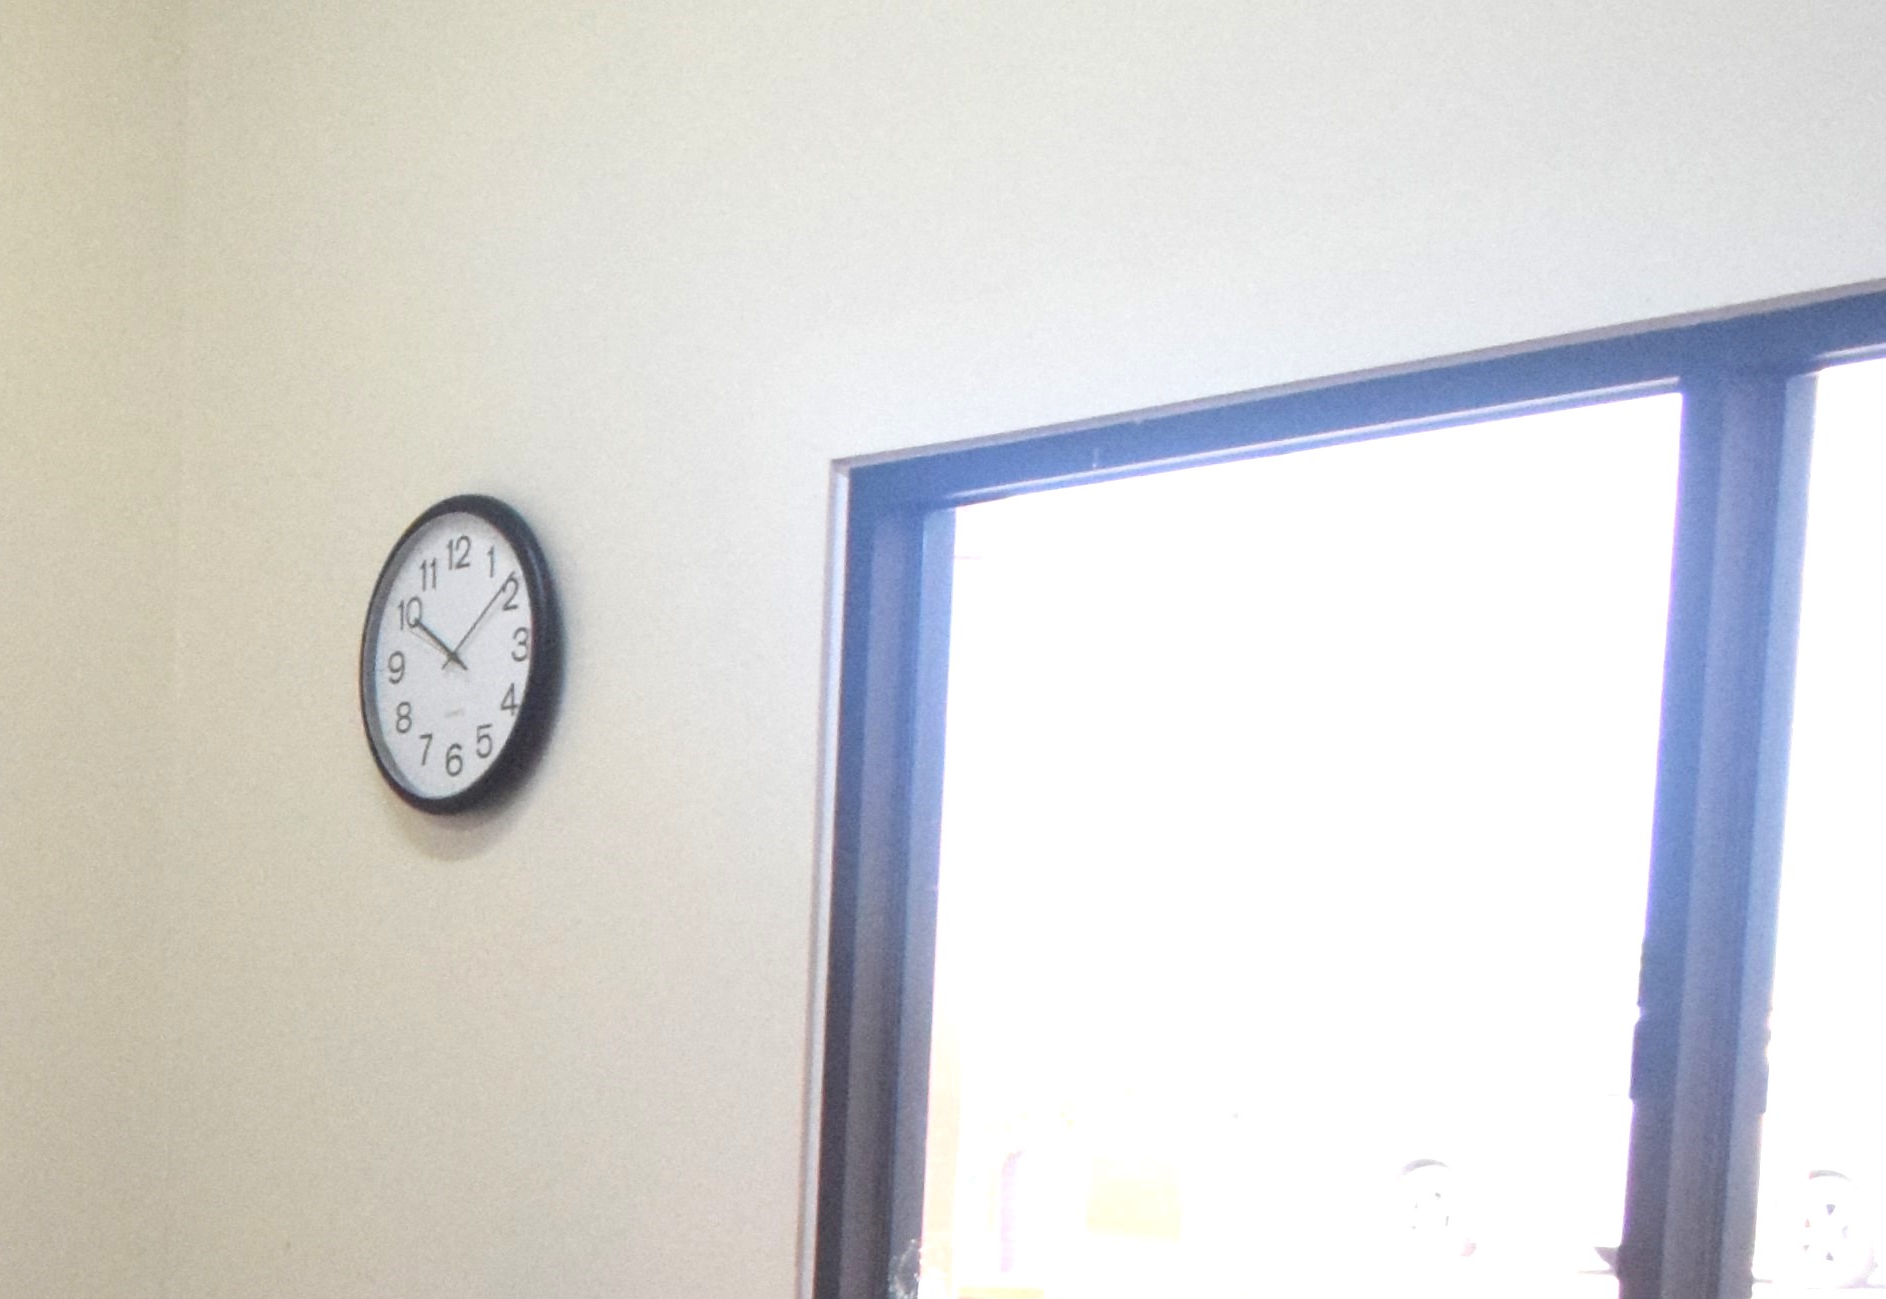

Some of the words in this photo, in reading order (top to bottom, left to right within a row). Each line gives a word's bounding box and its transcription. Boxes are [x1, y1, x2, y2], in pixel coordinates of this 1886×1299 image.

[446, 535, 472, 571] 12
[487, 546, 496, 578] 1
[419, 557, 438, 592] 11
[501, 575, 520, 611] 2
[398, 596, 423, 631] 10
[511, 626, 529, 662] 3
[388, 651, 406, 684] 9
[500, 683, 518, 716] 4
[395, 701, 413, 734] 8
[419, 734, 433, 767] 7
[476, 723, 493, 759] 5
[444, 743, 464, 777] 6
